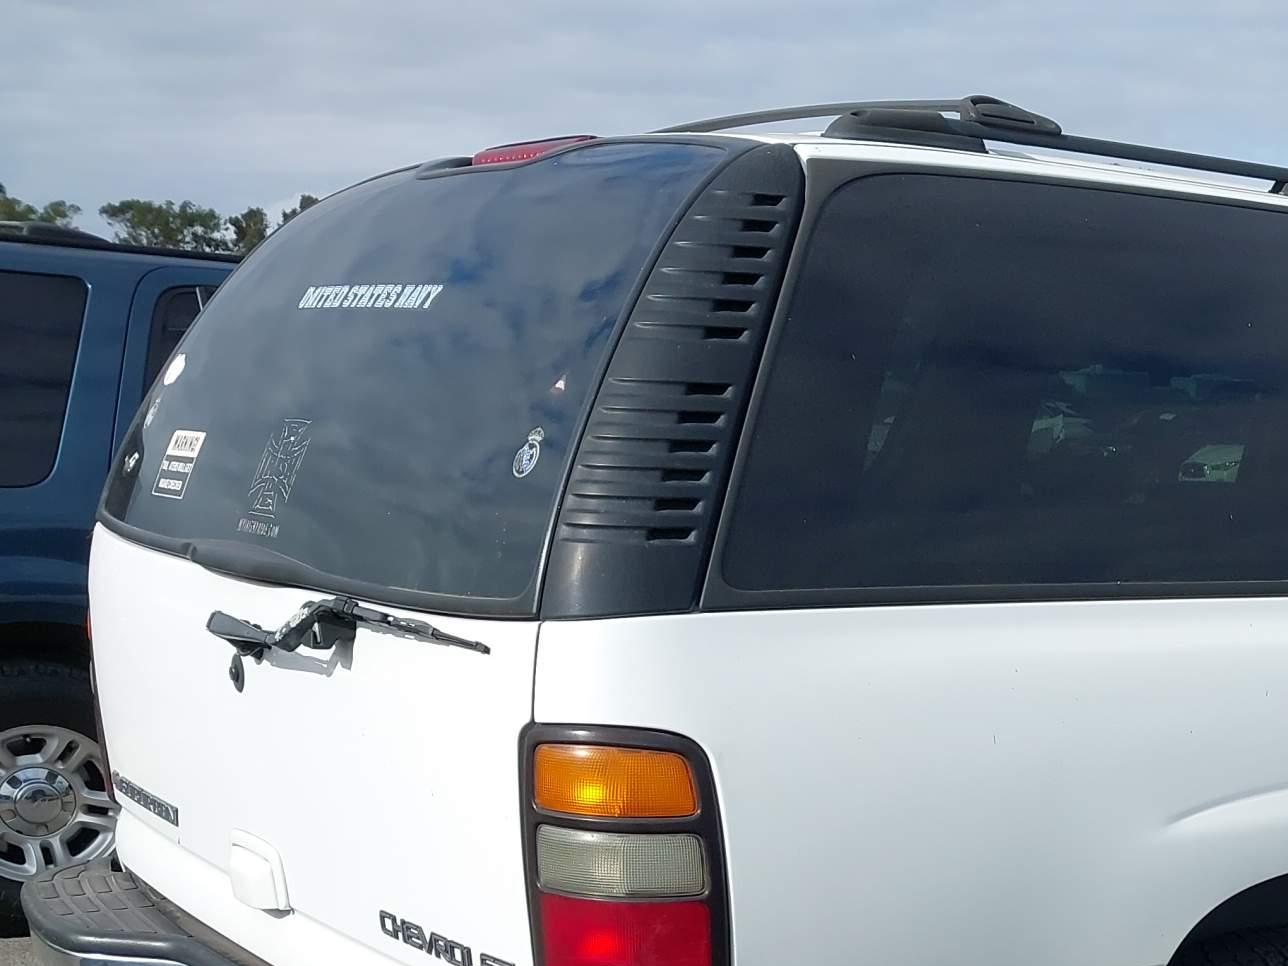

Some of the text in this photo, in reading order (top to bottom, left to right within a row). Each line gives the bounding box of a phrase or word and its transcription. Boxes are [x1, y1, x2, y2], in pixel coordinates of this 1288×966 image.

[298, 284, 444, 309] UNITED STATES NAVY
